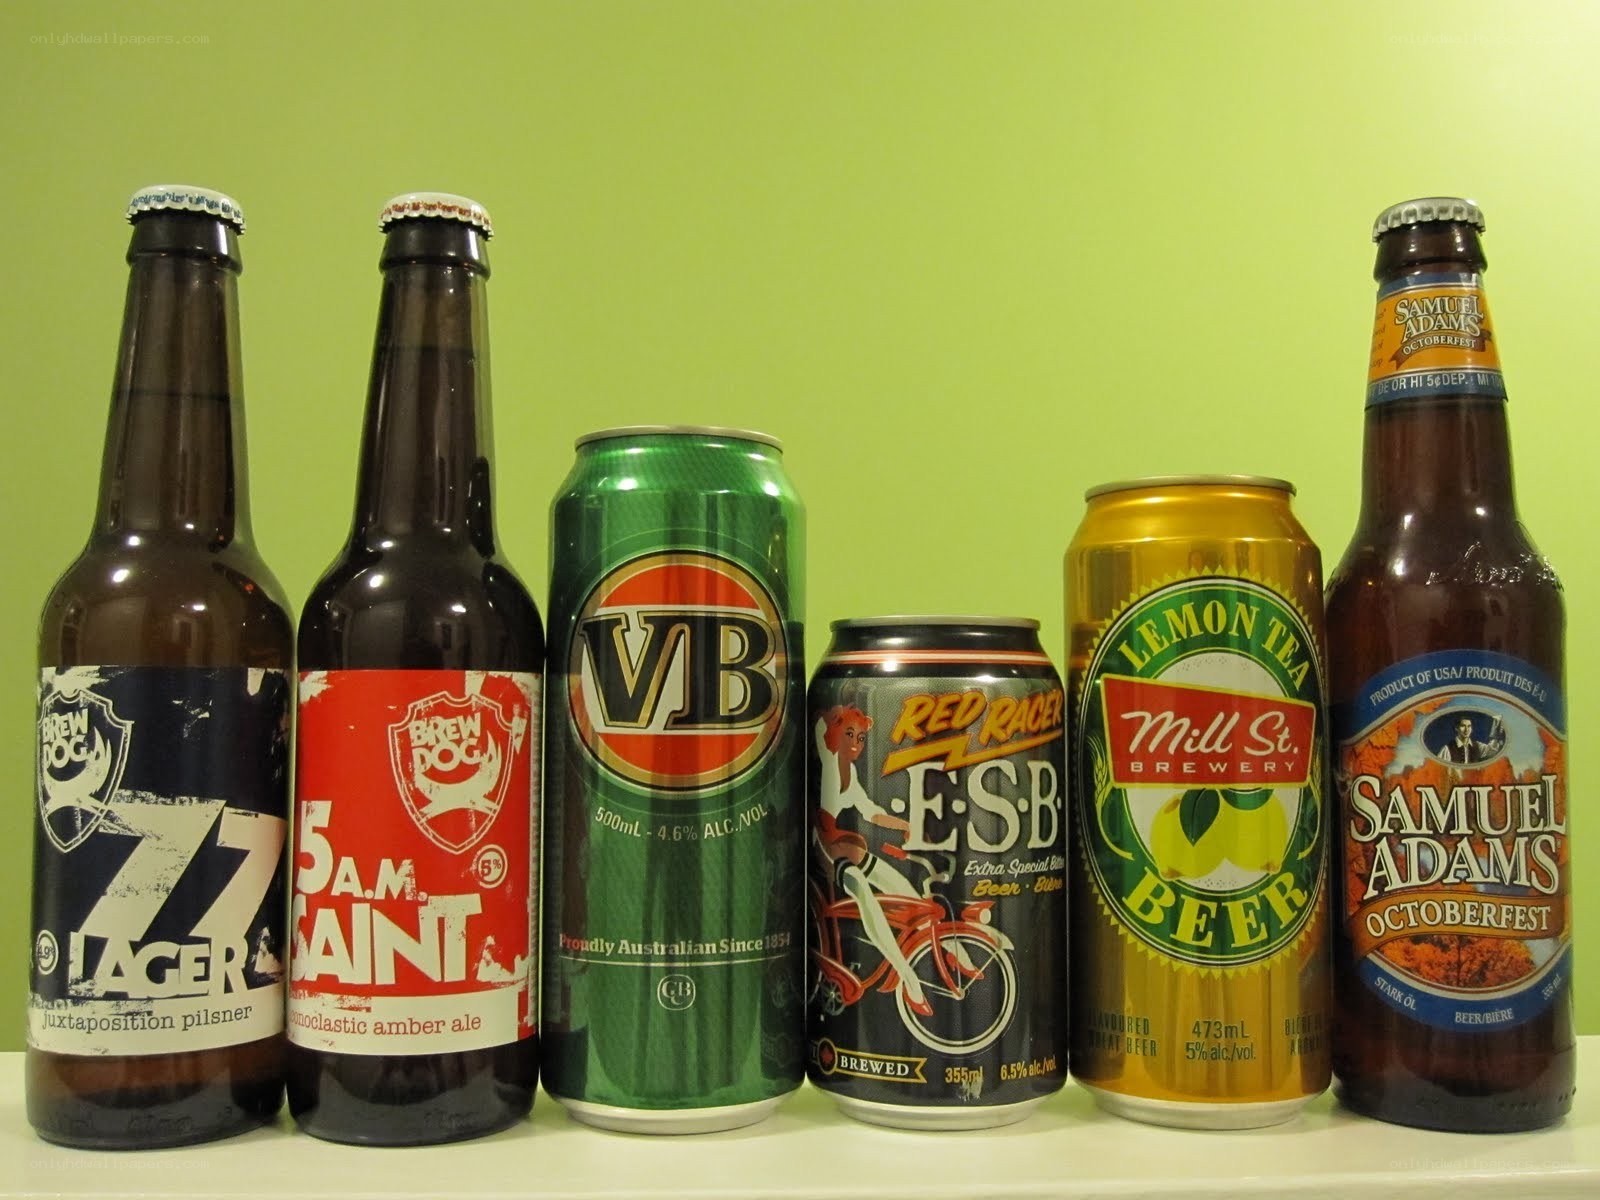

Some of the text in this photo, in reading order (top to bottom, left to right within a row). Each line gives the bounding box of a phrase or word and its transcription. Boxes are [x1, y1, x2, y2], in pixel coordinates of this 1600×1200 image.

[1395, 295, 1484, 325] SAMUEL
[1401, 314, 1482, 342] ADAMS
[1402, 335, 1477, 355] OCTOBERFEST
[1391, 377, 1407, 391] OR
[1410, 375, 1423, 389] HI
[1117, 600, 1310, 691] LEMON TEA
[578, 610, 780, 731] VB
[1369, 675, 1416, 706] PRODUCT
[1416, 669, 1432, 685] OF
[1466, 665, 1516, 686] PRODUIT
[1513, 675, 1533, 693] DES
[42, 708, 89, 743] BREW
[409, 712, 481, 748] BREW
[890, 689, 988, 745] RED
[1120, 710, 1299, 757] Mill St.
[42, 735, 88, 769] DOG
[412, 738, 482, 773] DOG
[1130, 761, 1296, 774] BREWERY
[1350, 774, 1567, 842] SAMUEL
[594, 806, 642, 838] 500mL
[657, 824, 699, 842] 4.6%
[480, 858, 502, 878] 5%
[963, 860, 1006, 876] Extra
[1007, 856, 1050, 878] Special
[1362, 834, 1560, 901] ADAMS
[972, 879, 1021, 897] Beer
[1121, 866, 1309, 948] BEER
[1365, 899, 1552, 938] OCTOBERFEST
[291, 893, 483, 985] SAINT
[559, 933, 615, 957] Proudly
[618, 939, 717, 956] Australian
[719, 935, 763, 953] Since
[68, 931, 250, 998] LAGER
[1374, 976, 1404, 1004] STARK
[42, 1004, 253, 1032] juxtaposition pilsner
[288, 1009, 482, 1035] conoclastic amber ale
[1191, 1020, 1251, 1039] 473mL
[1126, 1037, 1157, 1057] BEER
[1185, 1041, 1208, 1061] 5%
[840, 1054, 910, 1077] BREWED
[1000, 1060, 1027, 1081] 6.5%
